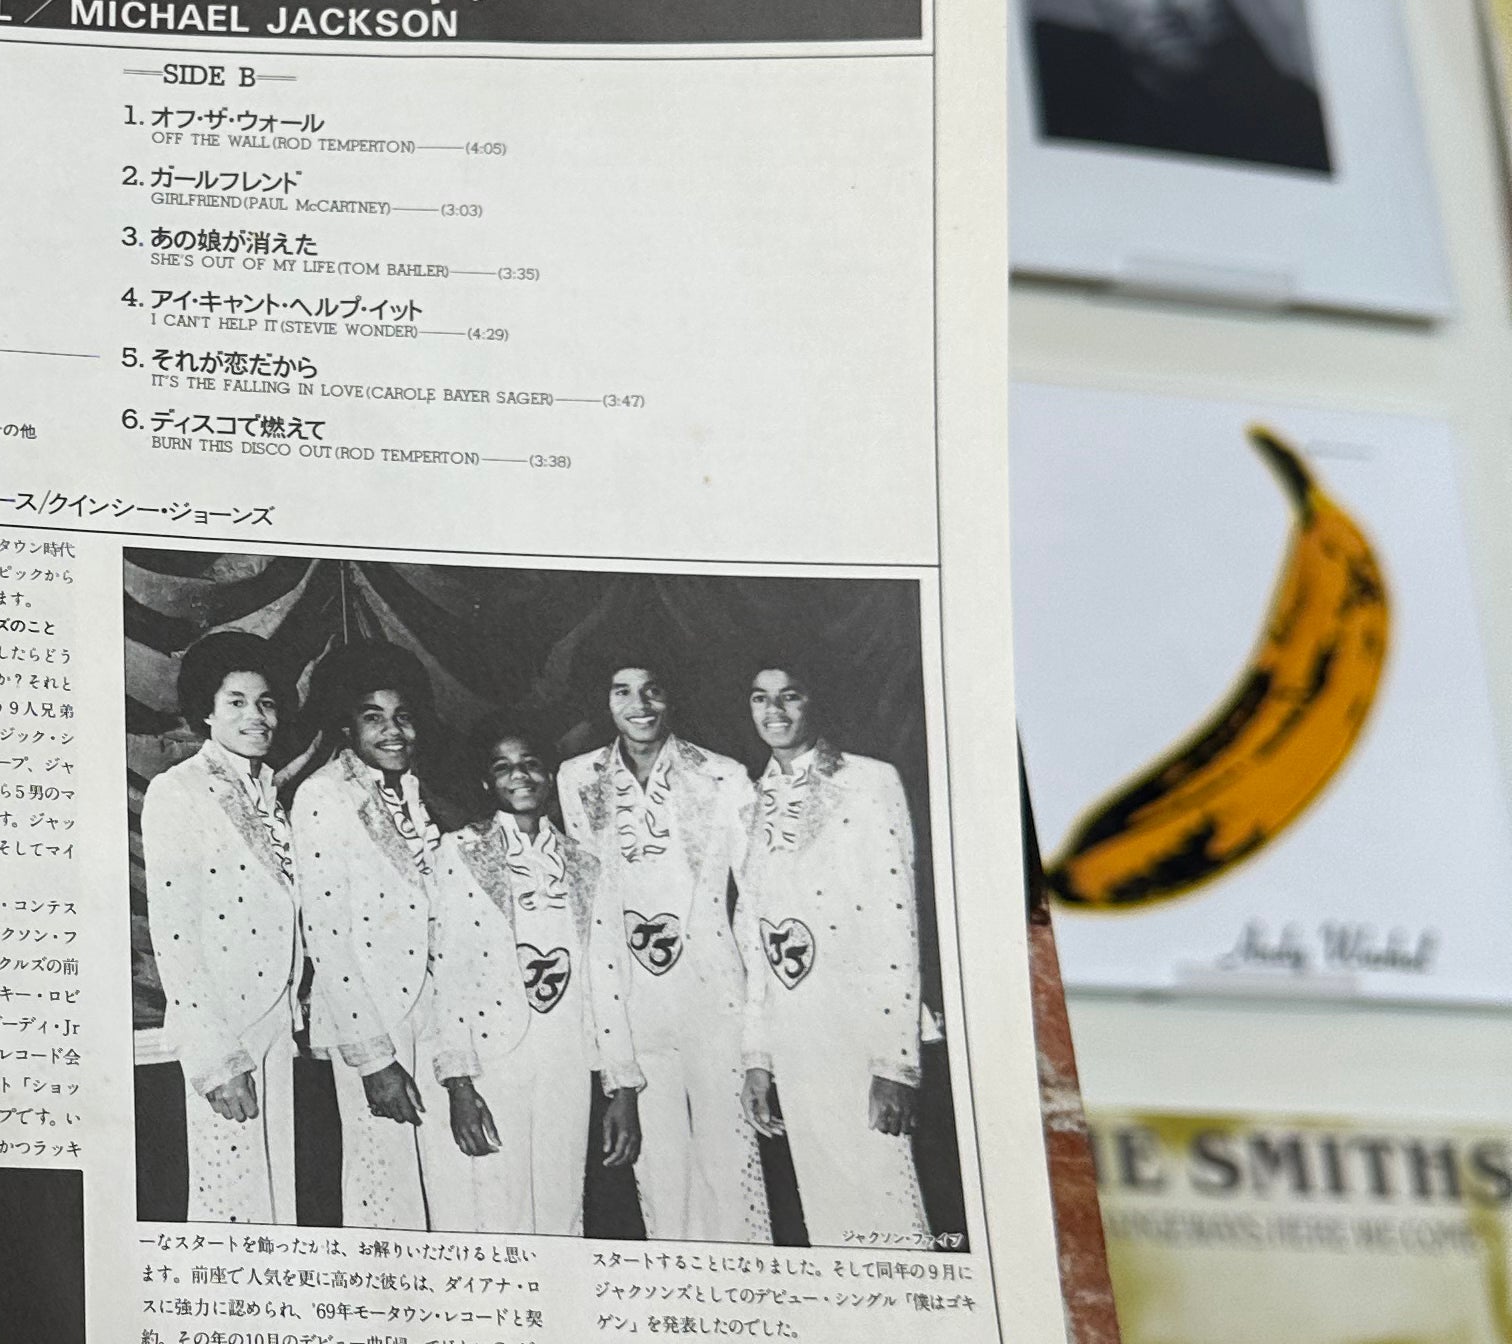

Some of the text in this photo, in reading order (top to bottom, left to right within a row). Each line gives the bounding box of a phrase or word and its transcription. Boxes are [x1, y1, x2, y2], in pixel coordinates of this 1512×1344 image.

[69, 0, 250, 33] MICHAEL
[266, 6, 458, 38] JACKSON
[163, 64, 256, 87] SIDE B
[124, 105, 145, 126] 1.
[152, 131, 507, 156] OFF THE TEMPERTON) (4:05)
[121, 165, 303, 194] 2. ガールフレンド
[440, 204, 483, 218] (3:03)
[121, 226, 318, 256] 3. あの娘が消えた
[150, 253, 194, 267] SHE'S
[201, 256, 235, 269] OUT
[242, 257, 265, 271] OF
[272, 259, 296, 273] MY
[497, 267, 540, 282] (3:35)
[121, 287, 144, 308] 4.
[151, 313, 509, 342] I CAN'T HELP WONDER) (4:29)
[121, 347, 318, 379] 5. それが恋だから
[151, 374, 645, 409] IT'S THE FALLING IN BAYER SAGER) (3:47)
[121, 408, 326, 440] 6. ディスコで燃えて
[152, 436, 572, 469] BURN THIS DISCO TEMPERTON) (3:38)
[1193, 1128, 1512, 1211] SMITHS
